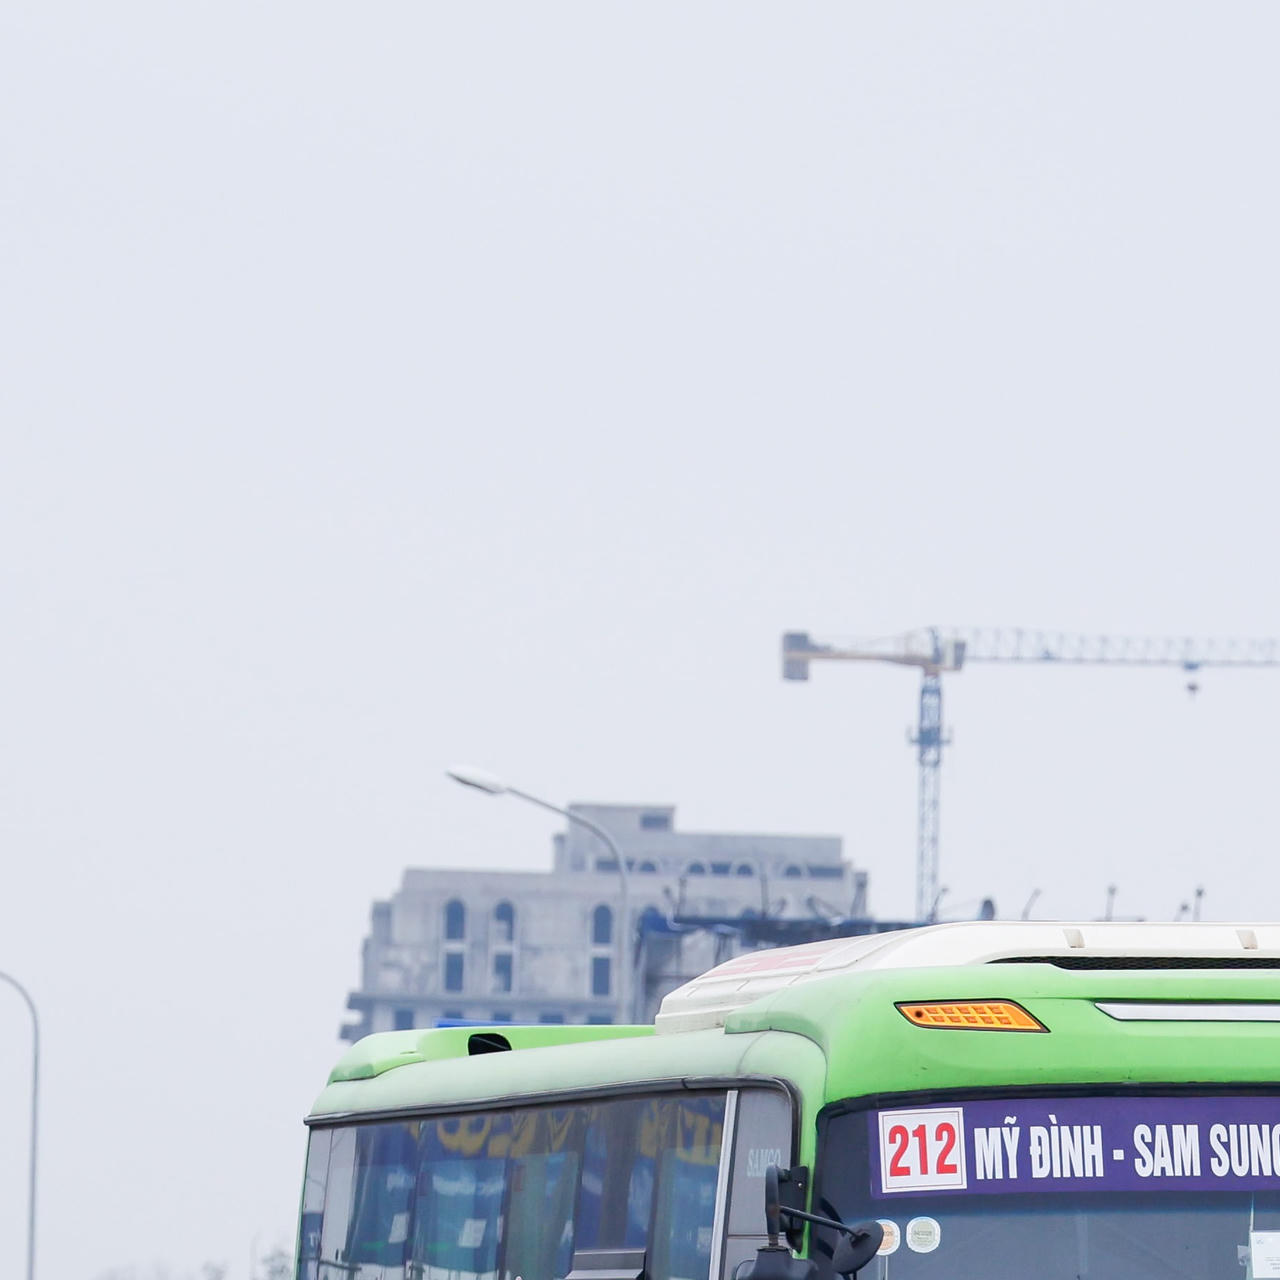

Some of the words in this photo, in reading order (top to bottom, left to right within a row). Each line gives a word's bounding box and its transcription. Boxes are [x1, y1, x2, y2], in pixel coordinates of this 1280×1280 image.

[888, 1122, 958, 1177] 212
[974, 1115, 1020, 1180] MỸ
[1029, 1114, 1104, 1179] ĐÌNH
[1133, 1124, 1201, 1178] SAM
